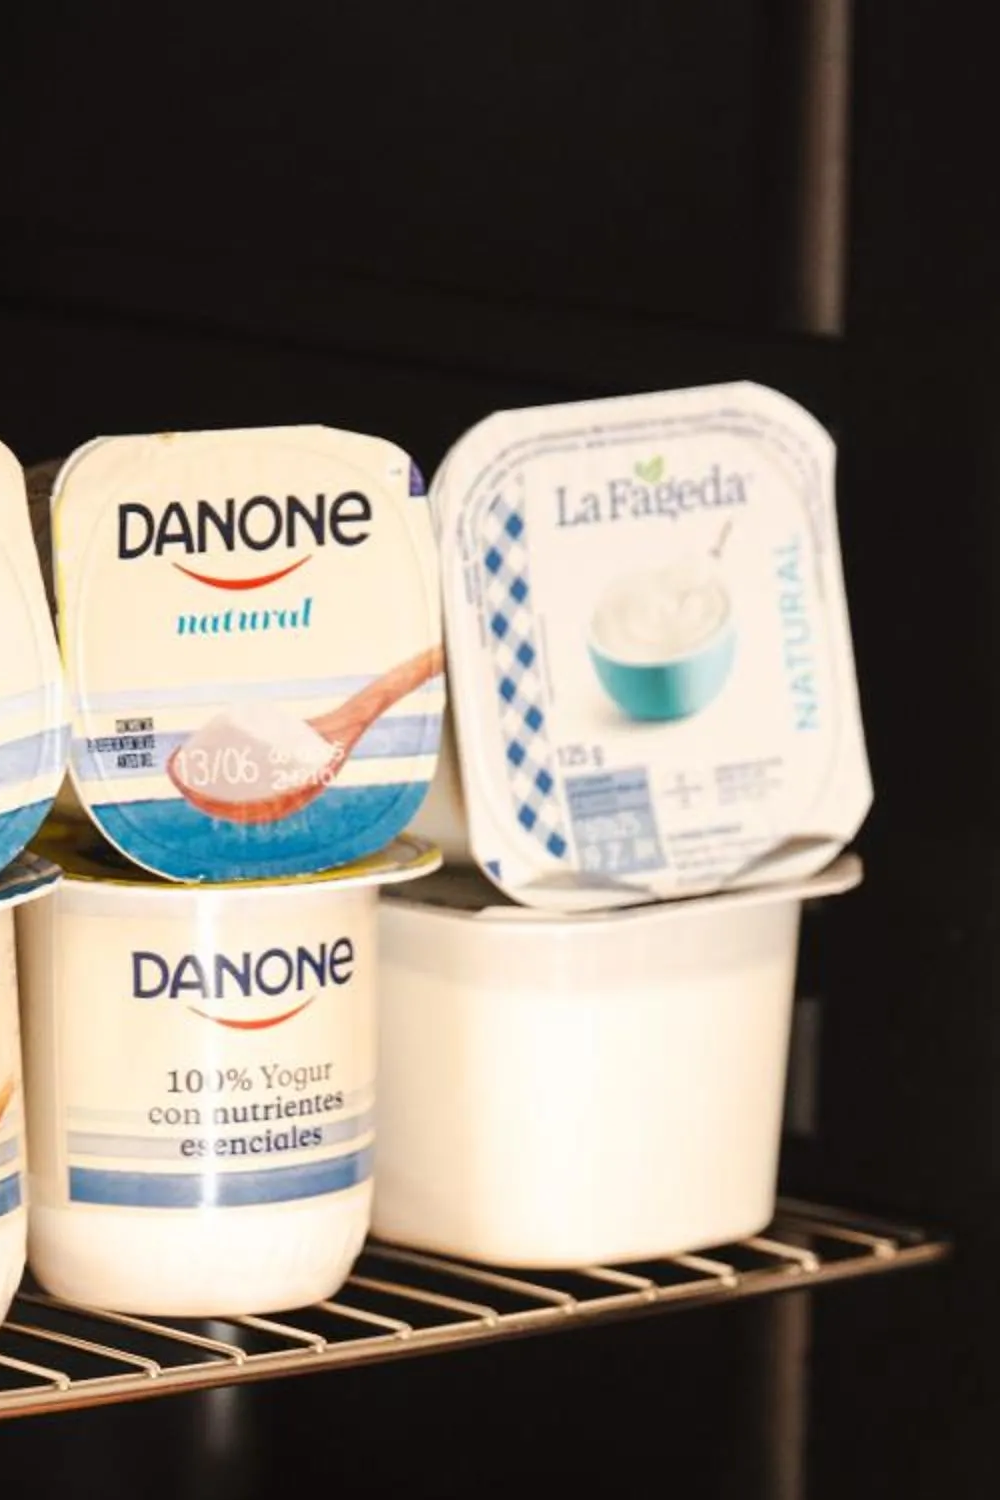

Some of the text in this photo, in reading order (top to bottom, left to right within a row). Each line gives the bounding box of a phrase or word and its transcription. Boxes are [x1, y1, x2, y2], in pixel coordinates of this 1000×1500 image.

[555, 464, 749, 528] La Fageda
[176, 598, 313, 635] natural
[771, 533, 819, 733] NATURAL
[260, 1061, 333, 1092] Yogur
[148, 1089, 345, 1126] con nutrientes
[180, 1125, 324, 1157] esenciales
